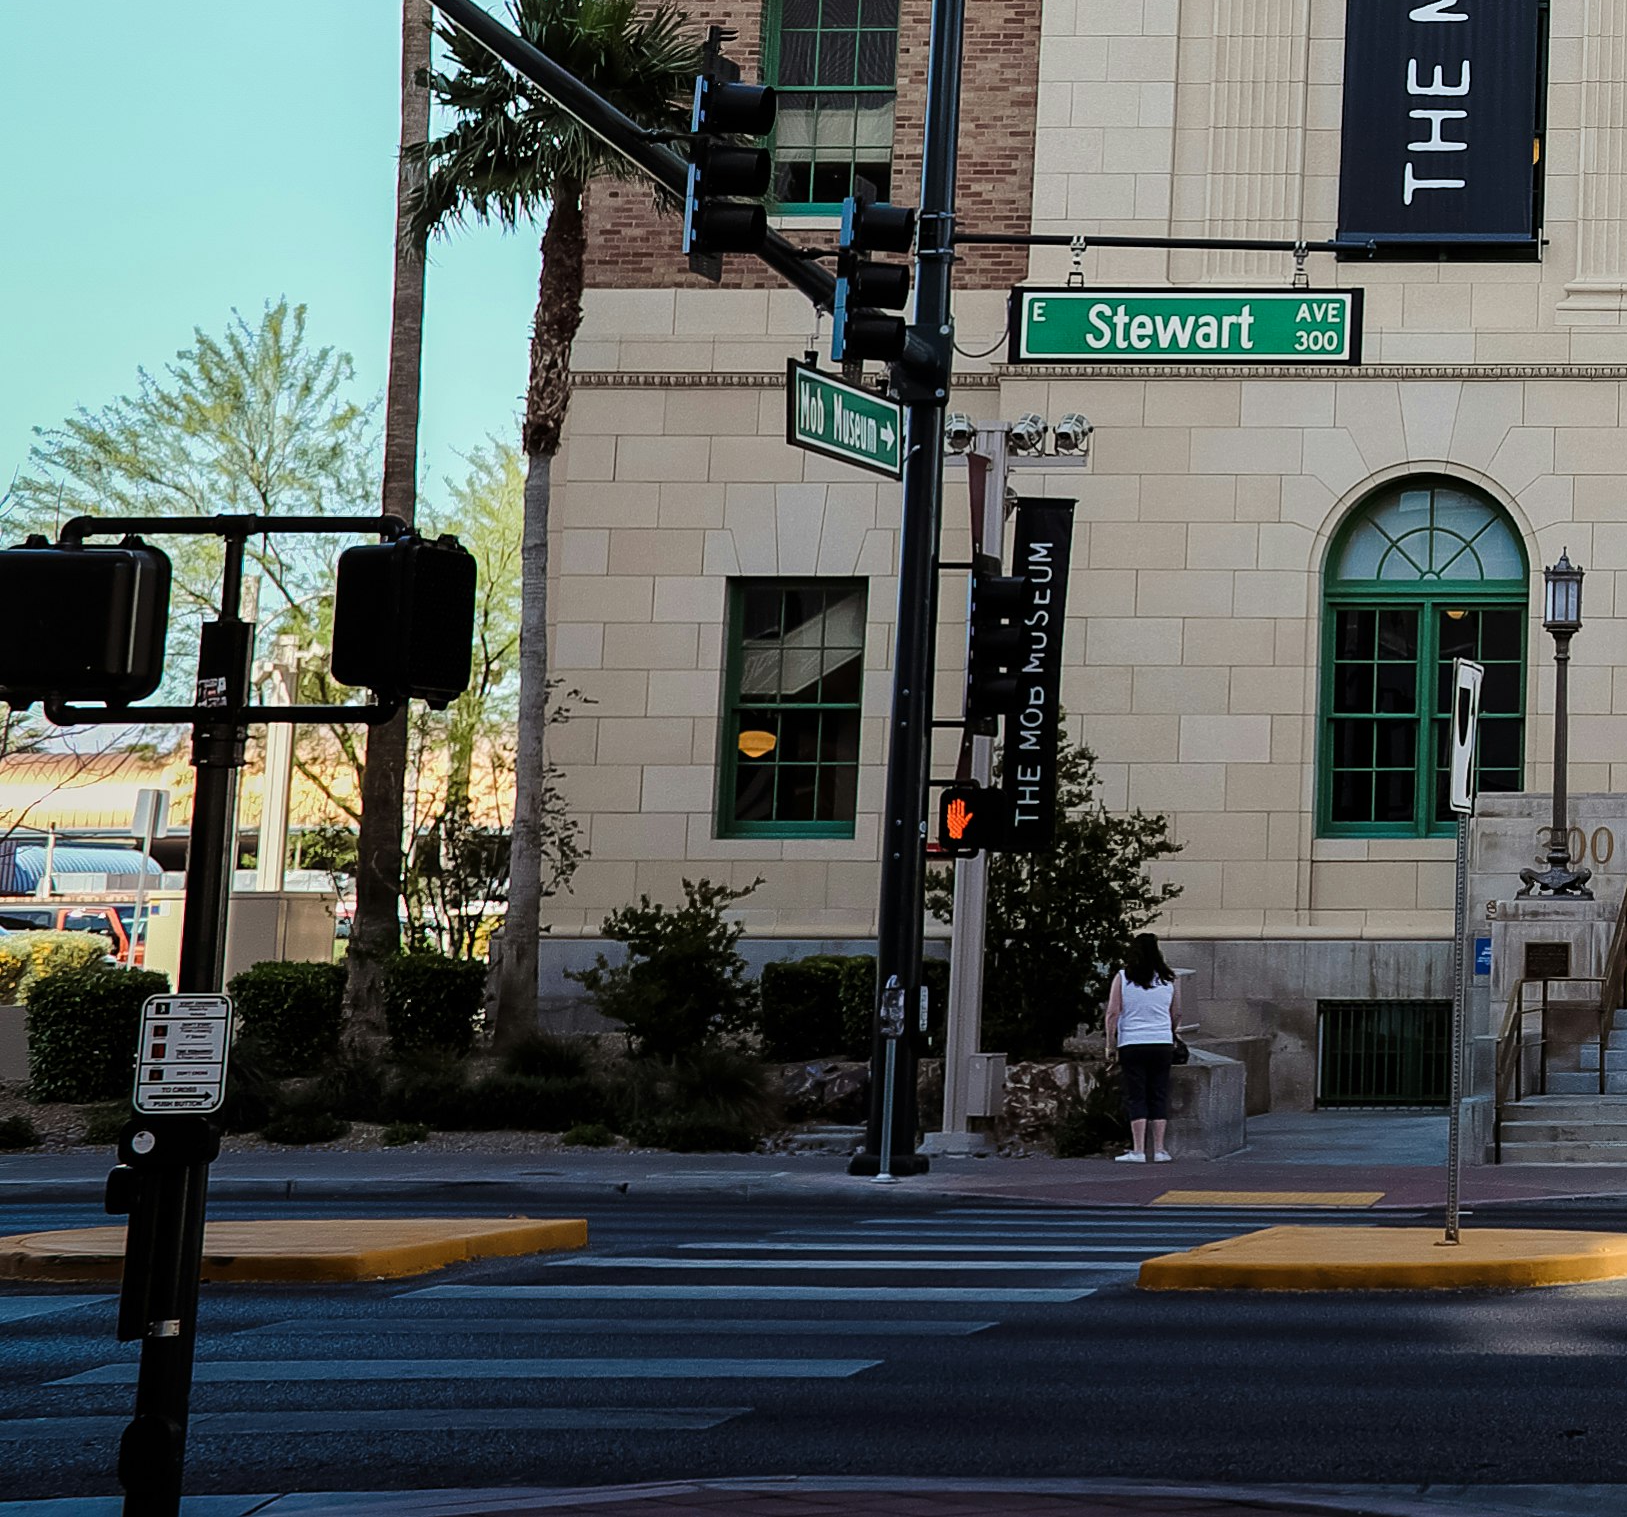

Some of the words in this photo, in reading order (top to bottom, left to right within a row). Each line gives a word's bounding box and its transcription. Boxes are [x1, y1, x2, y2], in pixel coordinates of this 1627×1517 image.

[1404, 58, 1472, 206] THE
[1033, 302, 1047, 322] E
[1085, 303, 1255, 350] Stewart
[1295, 302, 1342, 323] AVE
[1294, 330, 1339, 351] 300
[800, 380, 824, 435] Mob
[833, 392, 877, 454] Museum
[1021, 542, 1054, 673] MUSEUM
[1018, 686, 1045, 750] MOB
[1014, 765, 1041, 827] THE
